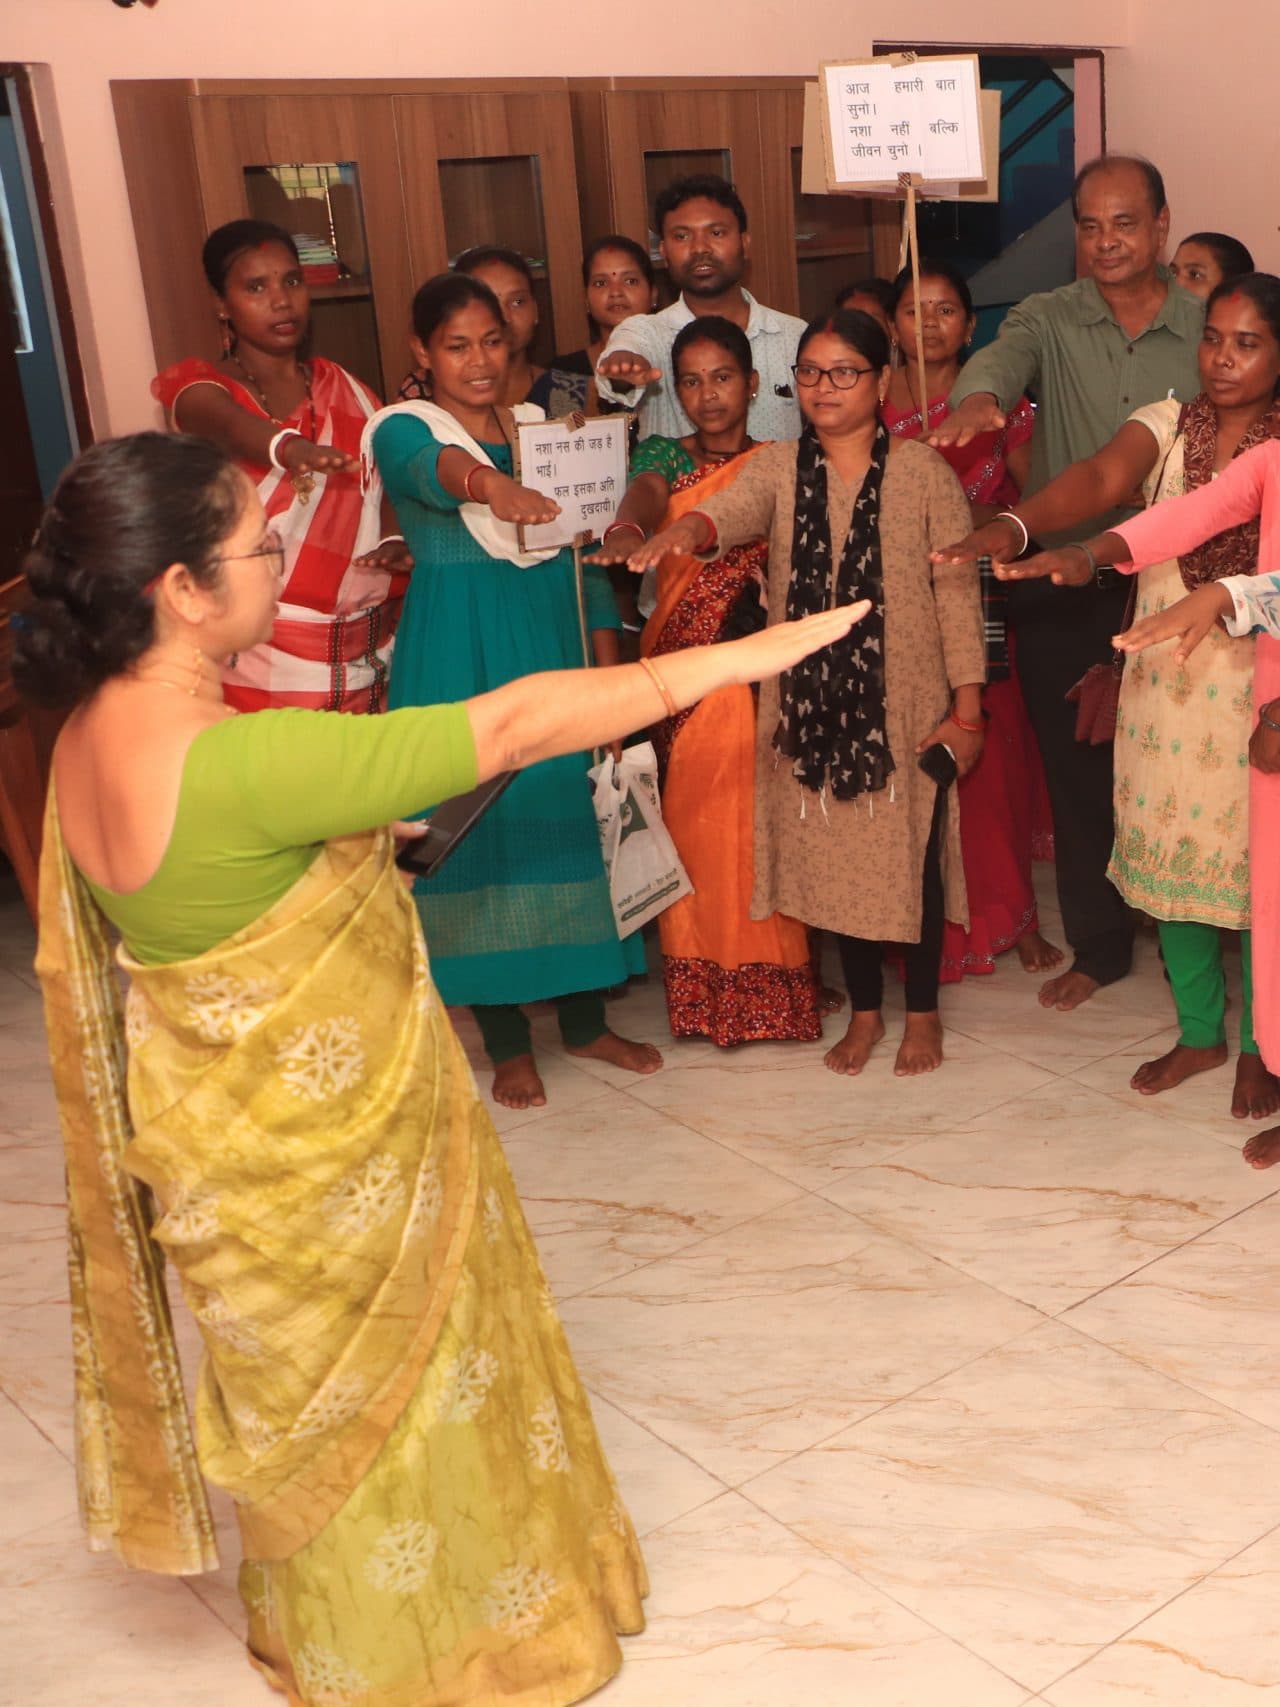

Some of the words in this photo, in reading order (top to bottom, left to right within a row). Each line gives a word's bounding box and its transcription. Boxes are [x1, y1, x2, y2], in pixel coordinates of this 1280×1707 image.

[846, 83, 870, 95] आज
[894, 77, 924, 93] हमारी
[936, 79, 956, 91] बात
[849, 125, 872, 137] नशा
[889, 120, 910, 136] नहीं
[929, 119, 959, 134] बल्कि
[851, 143, 881, 158] जीवन
[888, 142, 908, 160] चुनो
[535, 443, 552, 455] नशा
[556, 441, 570, 453] नस
[574, 436, 585, 451] की
[605, 433, 613, 449] है
[554, 486, 570, 498] फल
[573, 482, 596, 498] इसका
[600, 476, 615, 492] अति
